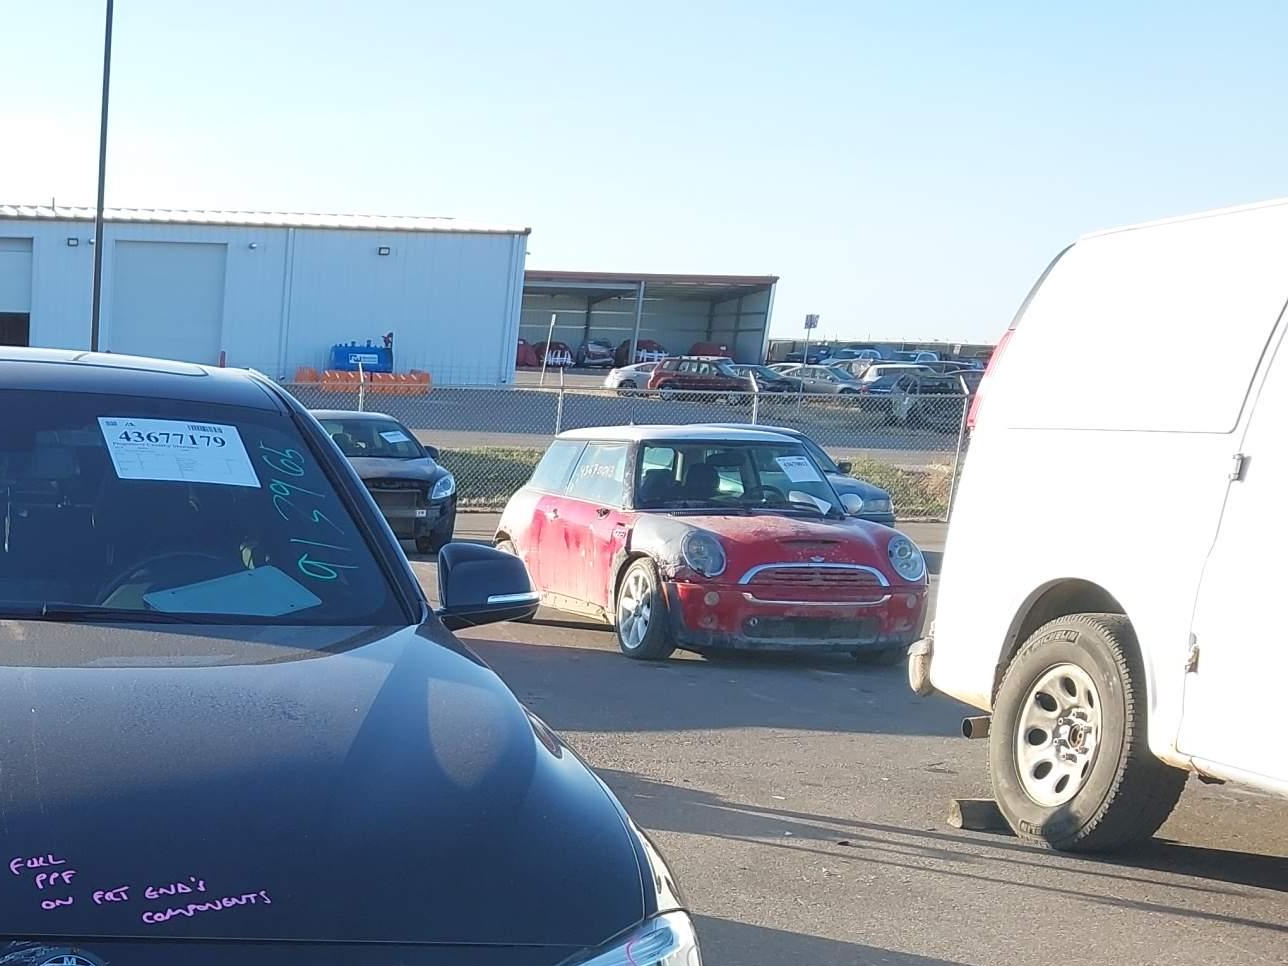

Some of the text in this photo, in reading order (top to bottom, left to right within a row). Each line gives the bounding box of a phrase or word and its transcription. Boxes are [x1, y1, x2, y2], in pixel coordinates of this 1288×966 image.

[119, 430, 226, 448] 43677179
[35, 870, 77, 889] PPF
[41, 896, 73, 910] ON
[92, 886, 130, 905] FRT
[142, 889, 273, 924] COMPONENTS
